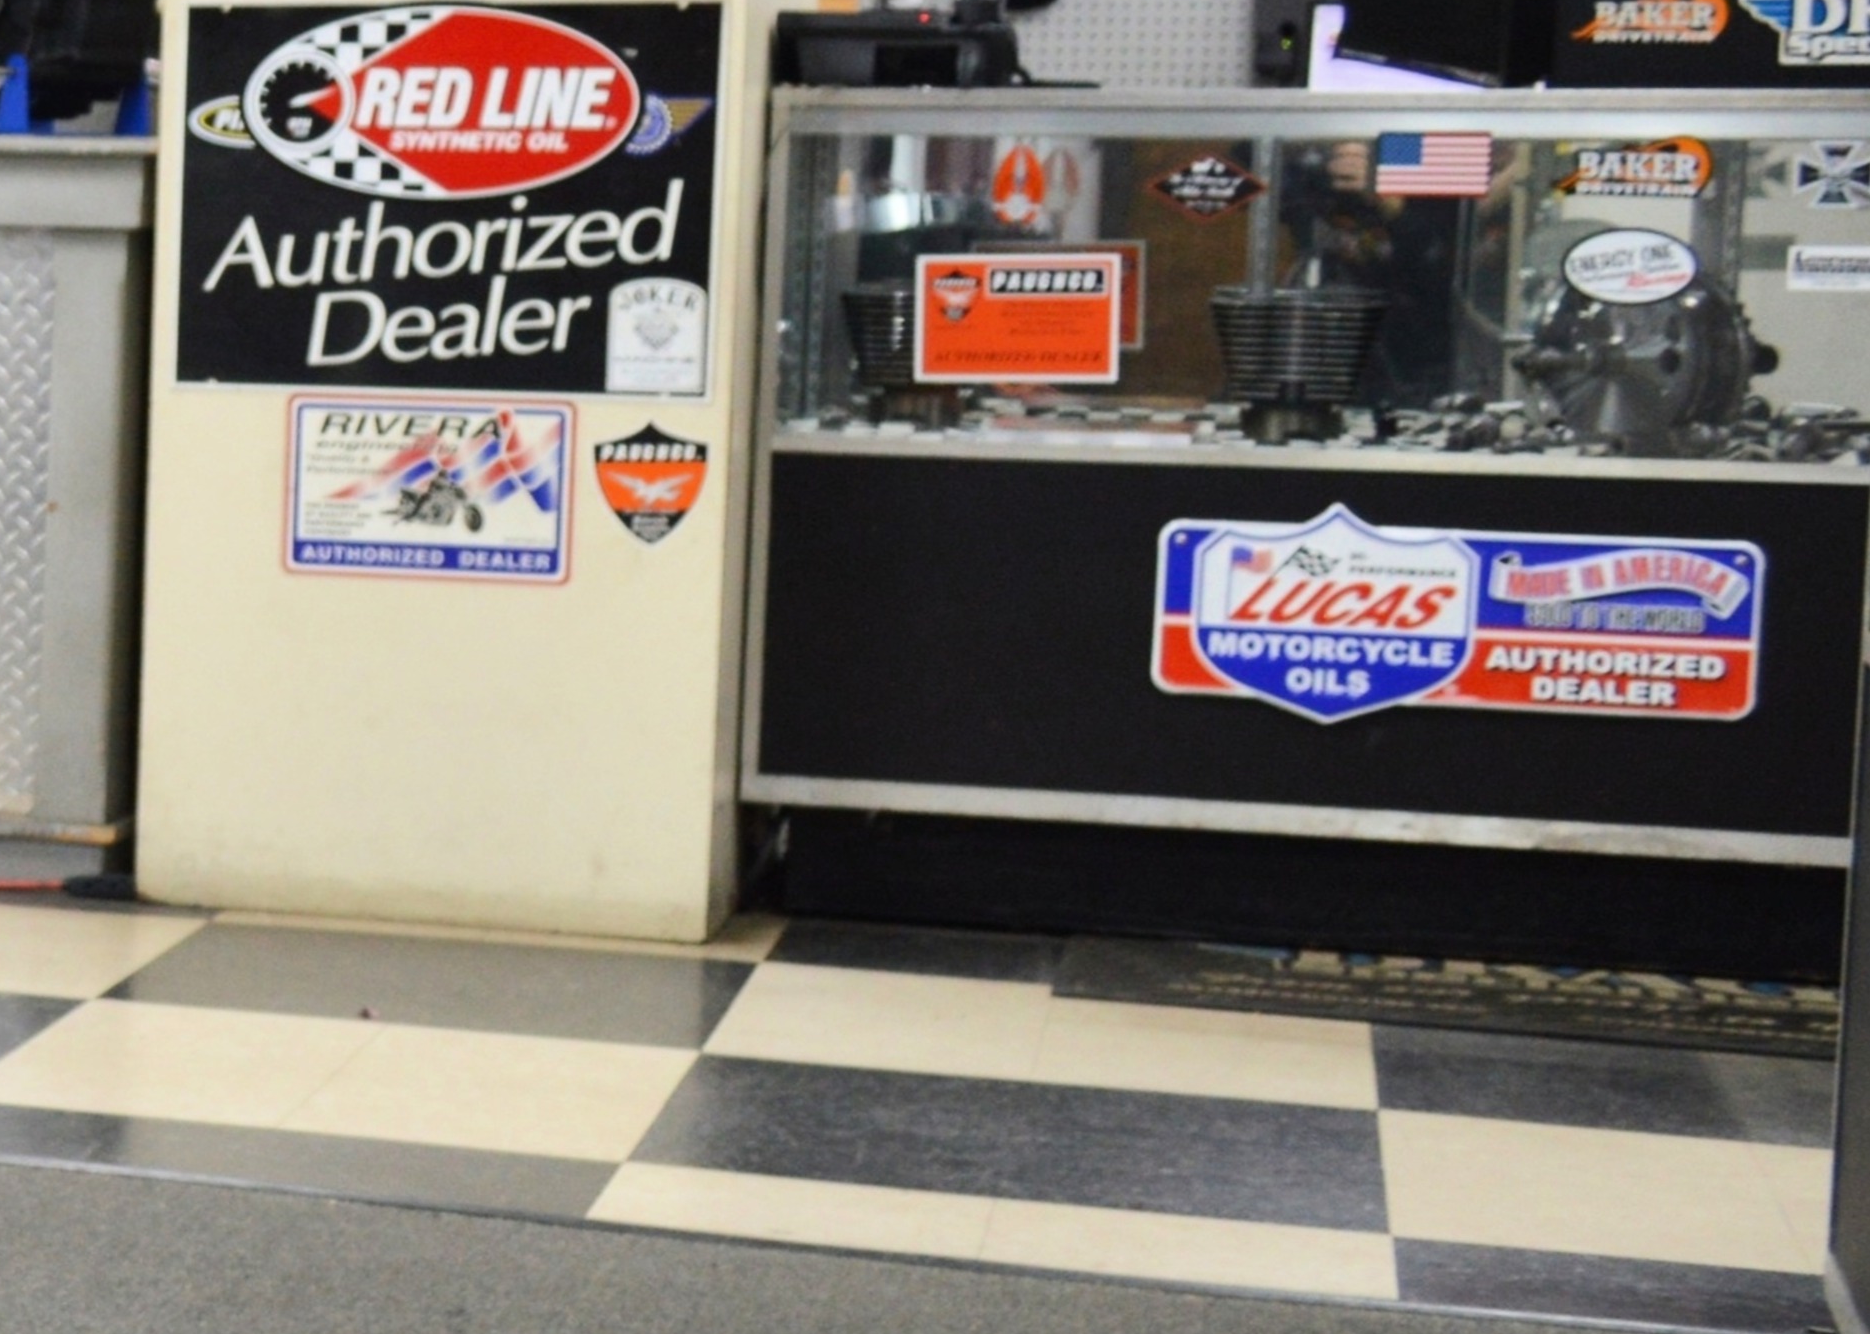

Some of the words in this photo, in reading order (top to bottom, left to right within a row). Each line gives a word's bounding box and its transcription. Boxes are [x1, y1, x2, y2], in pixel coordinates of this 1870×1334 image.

[1594, 1, 1716, 29] BAKER
[356, 66, 474, 129] RED
[479, 67, 616, 130] LINE
[389, 130, 522, 153] SYNTHETIC
[526, 131, 569, 154] OIL
[1577, 151, 1698, 181] BAKER
[203, 178, 685, 292] Authorized
[618, 286, 698, 312] JOKER
[306, 275, 592, 366] Dealer
[321, 412, 501, 438] RIVERA
[301, 543, 445, 565] AUTHORIZED
[457, 548, 551, 569] DEALER
[1505, 568, 1571, 598] MADE
[1580, 563, 1605, 591] IN
[1614, 555, 1730, 596] AMERICA
[1228, 578, 1457, 630] LUCAS
[1208, 631, 1456, 667] MOTORCYCLE
[1486, 644, 1727, 680] AUTHORIZED
[1285, 666, 1371, 698] OILS
[1530, 675, 1677, 707] DEALER
